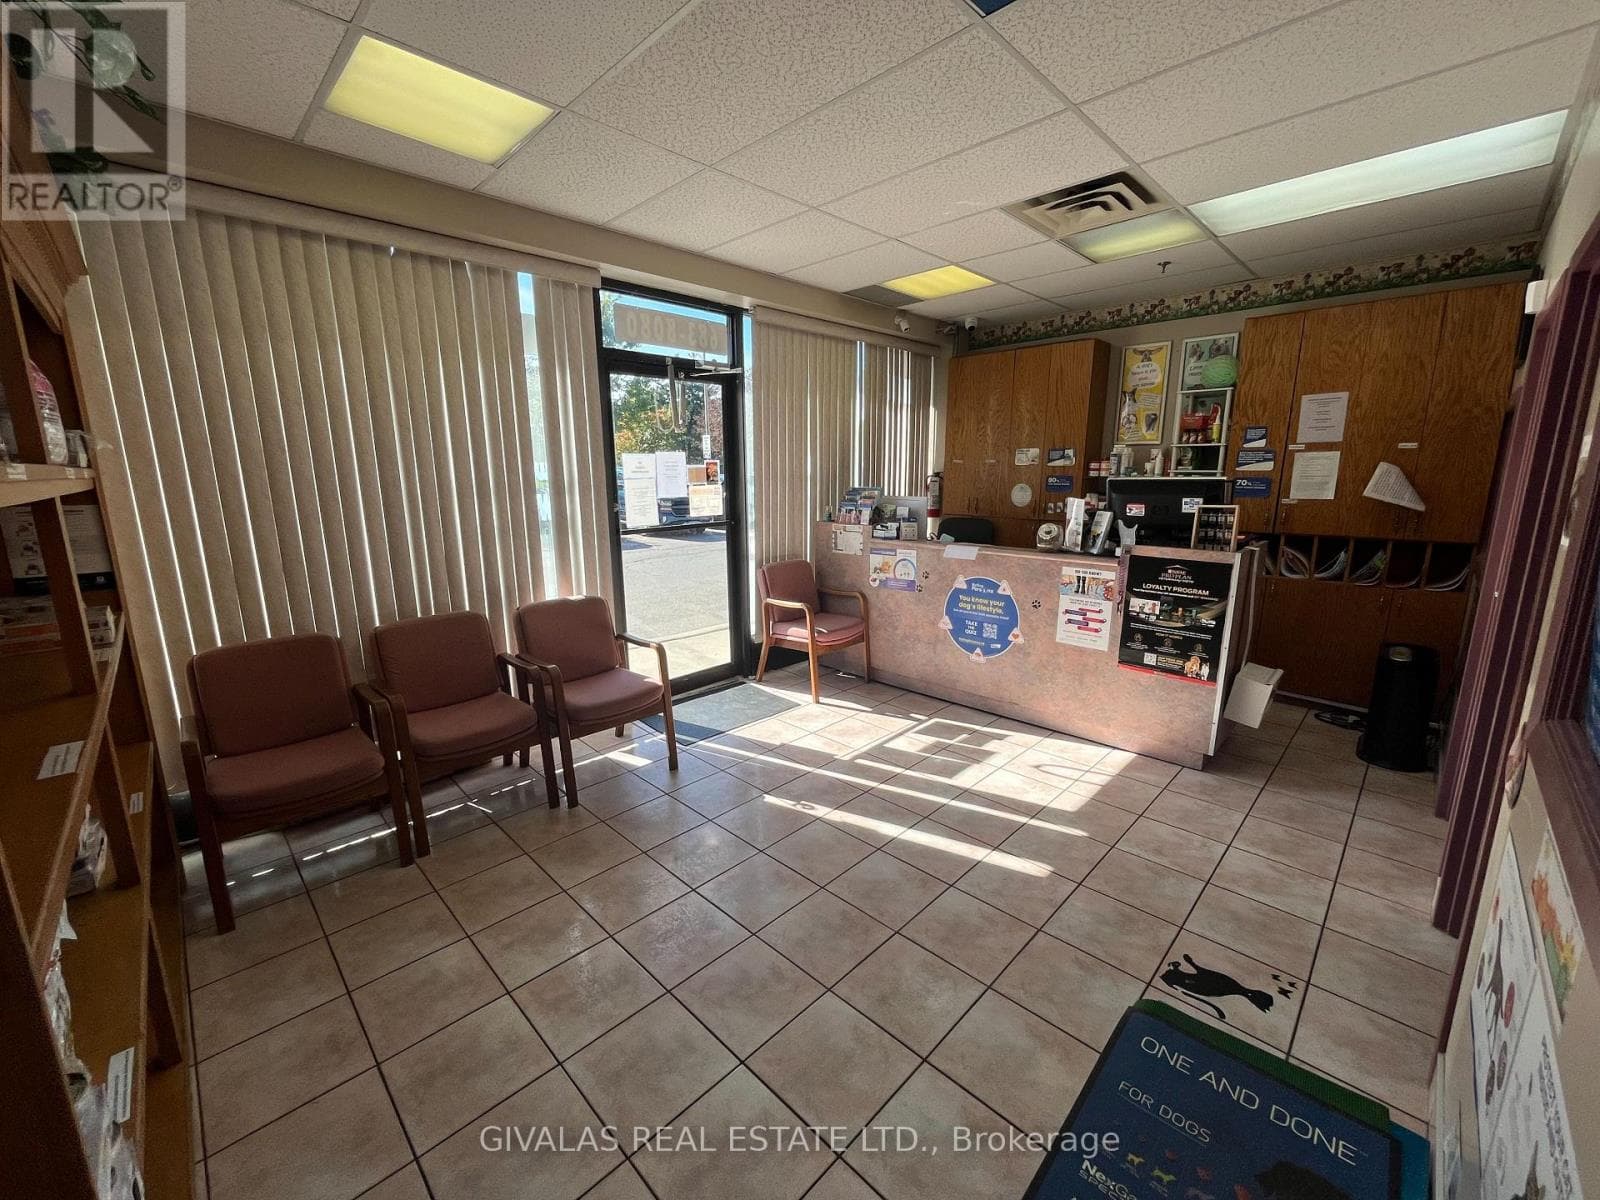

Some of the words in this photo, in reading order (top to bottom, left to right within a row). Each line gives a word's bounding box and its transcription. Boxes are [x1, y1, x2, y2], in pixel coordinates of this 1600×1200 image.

[959, 594, 971, 602] You
[1142, 583, 1172, 592] LOYALTY
[1172, 586, 1209, 596] PROGRAM
[1118, 1080, 1155, 1109] FOR
[1159, 1104, 1212, 1143] DOGS
[1140, 1036, 1195, 1075] ONE
[1199, 1071, 1260, 1110] AND
[1269, 1104, 1362, 1166] DONE
